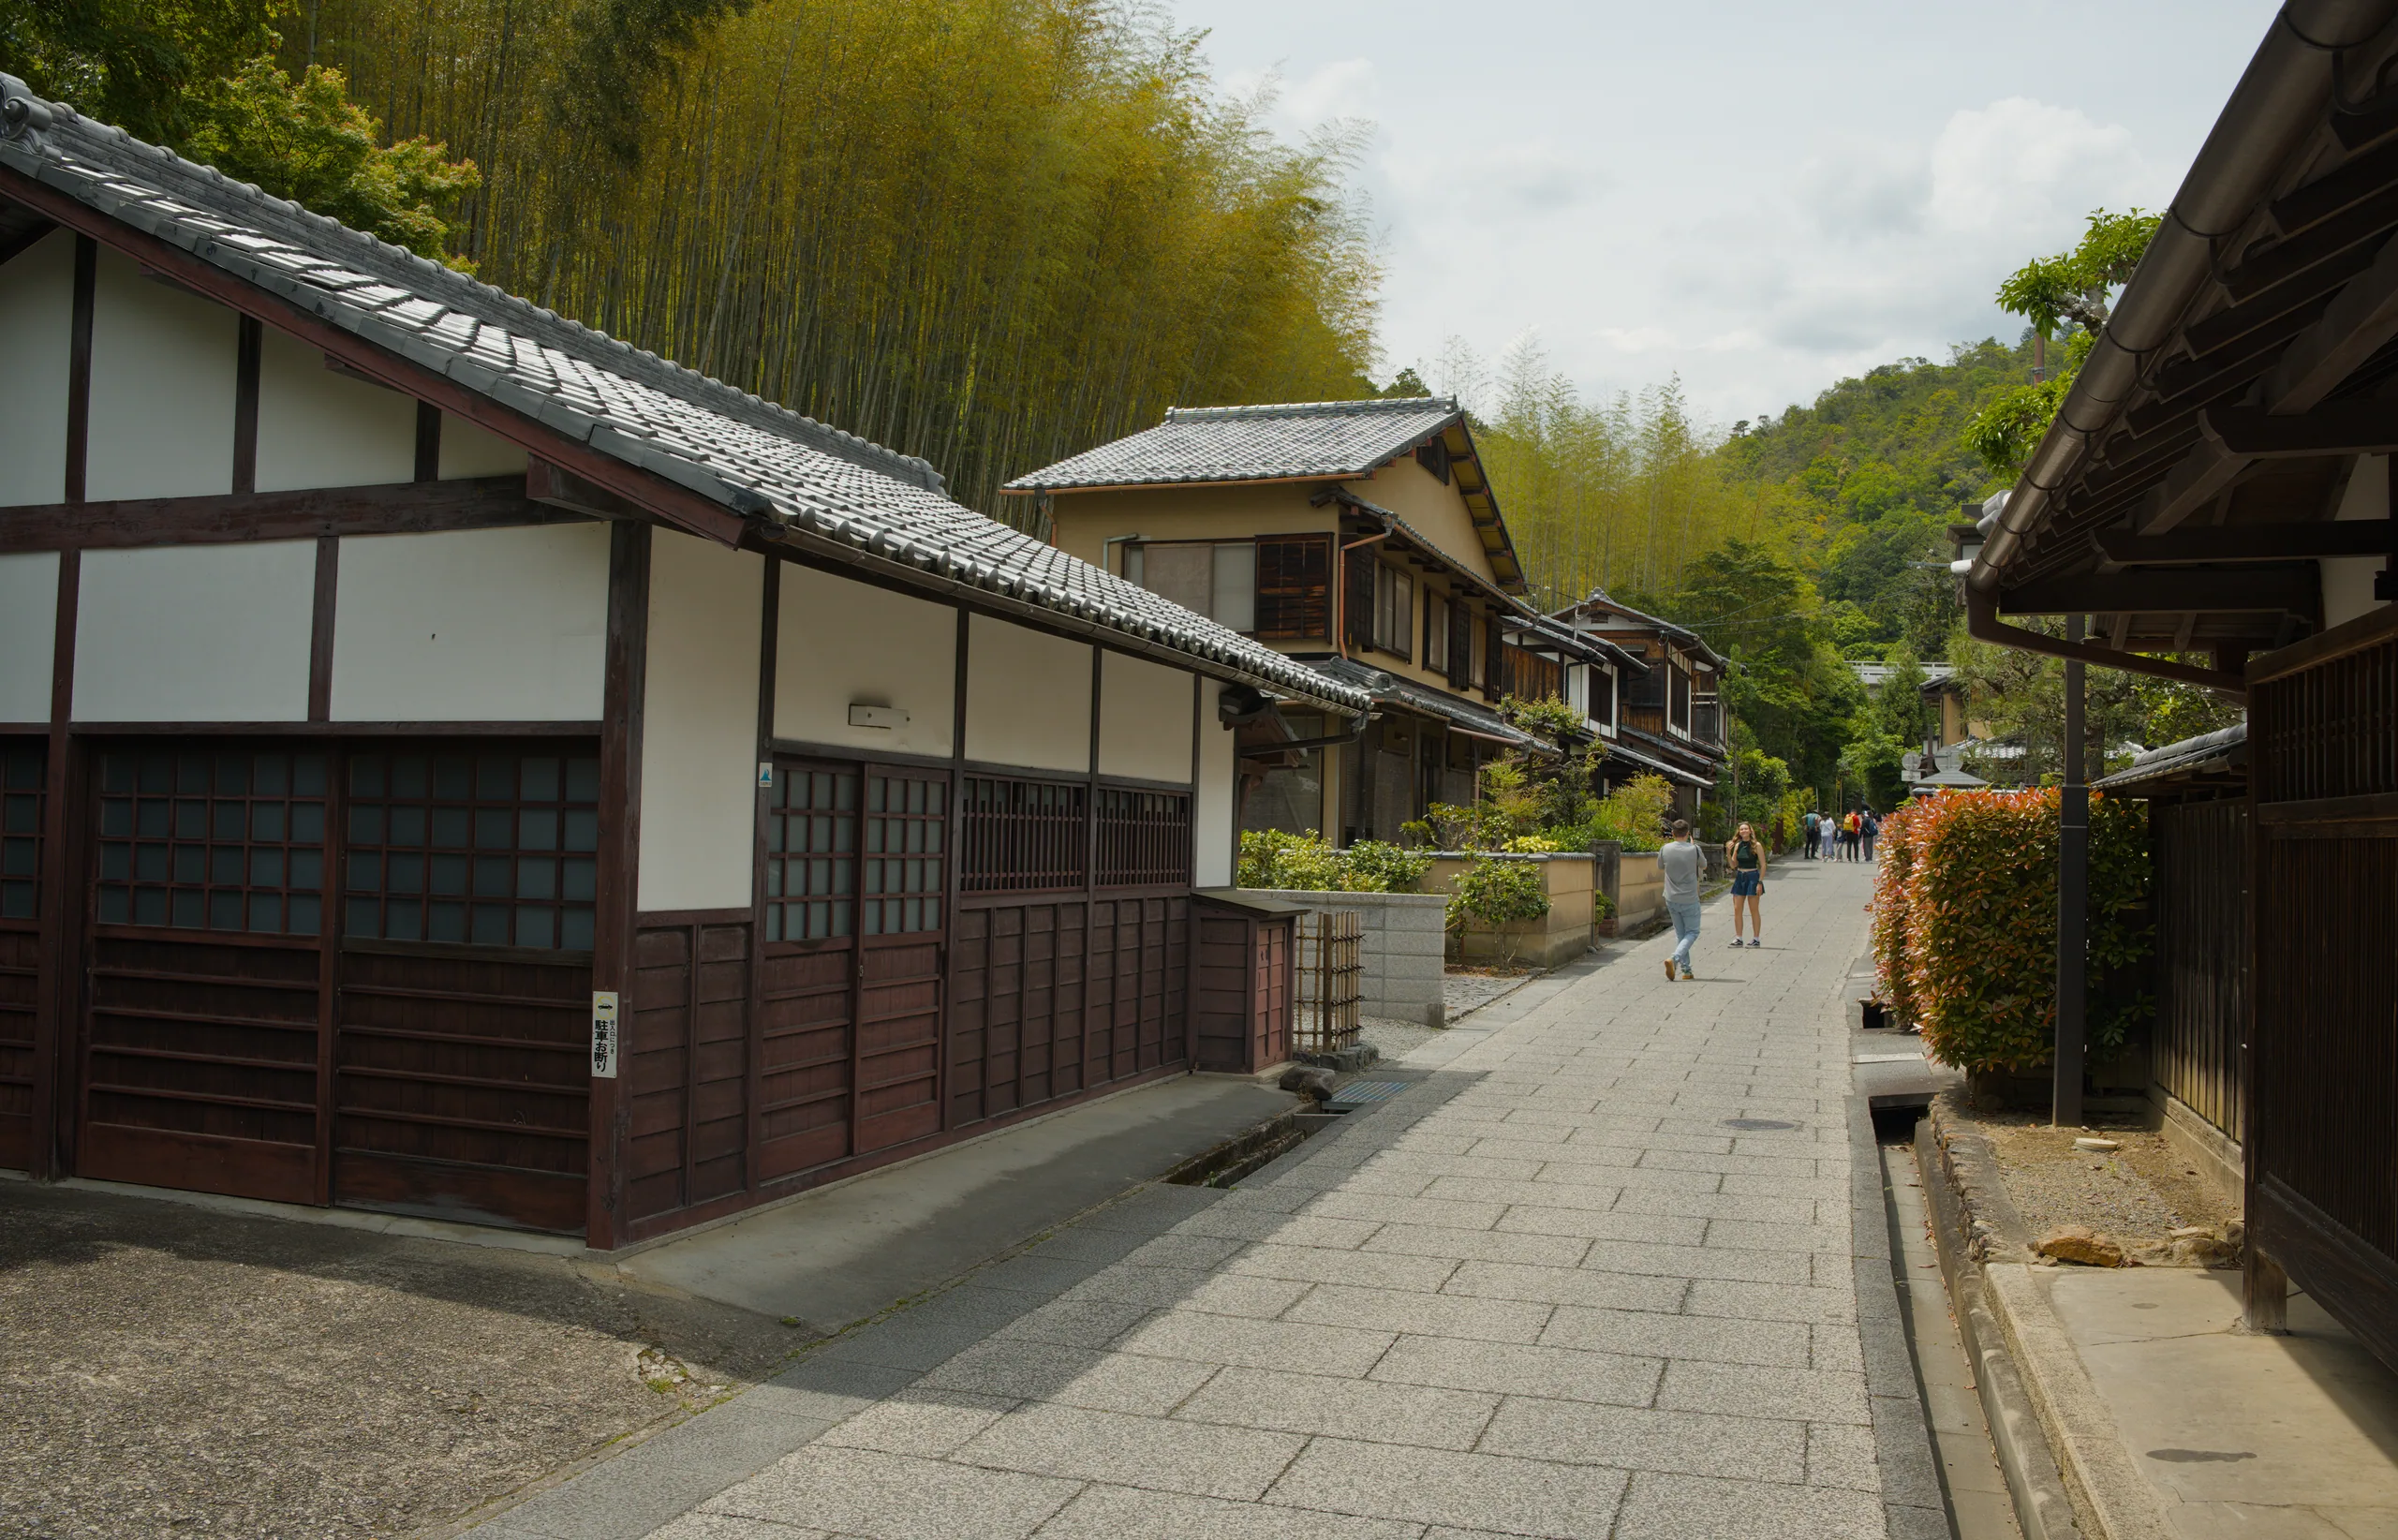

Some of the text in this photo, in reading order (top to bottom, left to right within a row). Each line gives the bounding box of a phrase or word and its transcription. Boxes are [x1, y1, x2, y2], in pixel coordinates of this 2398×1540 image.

[594, 1019, 609, 1073] 駐車お断り
